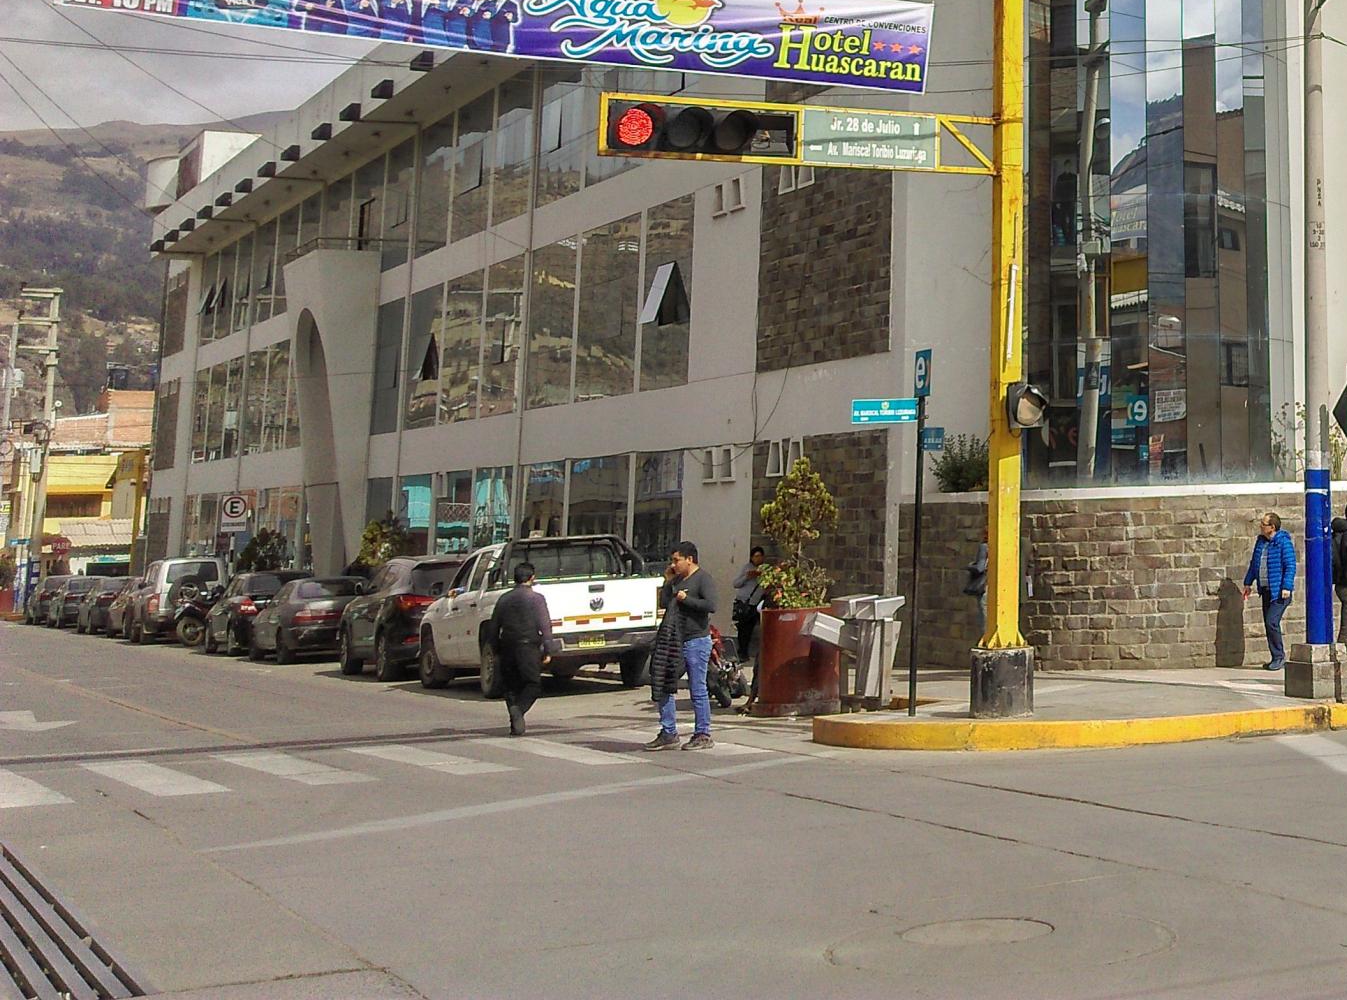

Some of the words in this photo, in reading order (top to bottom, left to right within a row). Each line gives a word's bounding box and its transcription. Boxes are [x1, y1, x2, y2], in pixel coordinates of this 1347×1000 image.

[824, 16, 854, 26] CENTRO
[868, 20, 927, 34] CONVENCIONES
[561, 21, 775, 68] Marina
[830, 116, 844, 132] Jr.
[846, 117, 859, 132] 28
[861, 118, 875, 133] de
[876, 119, 901, 135] Julio
[827, 141, 839, 156] Av.
[842, 142, 871, 158] Mariscal
[872, 143, 894, 159] Toribio
[230, 501, 240, 514] E
[53, 542, 70, 550] PARE
